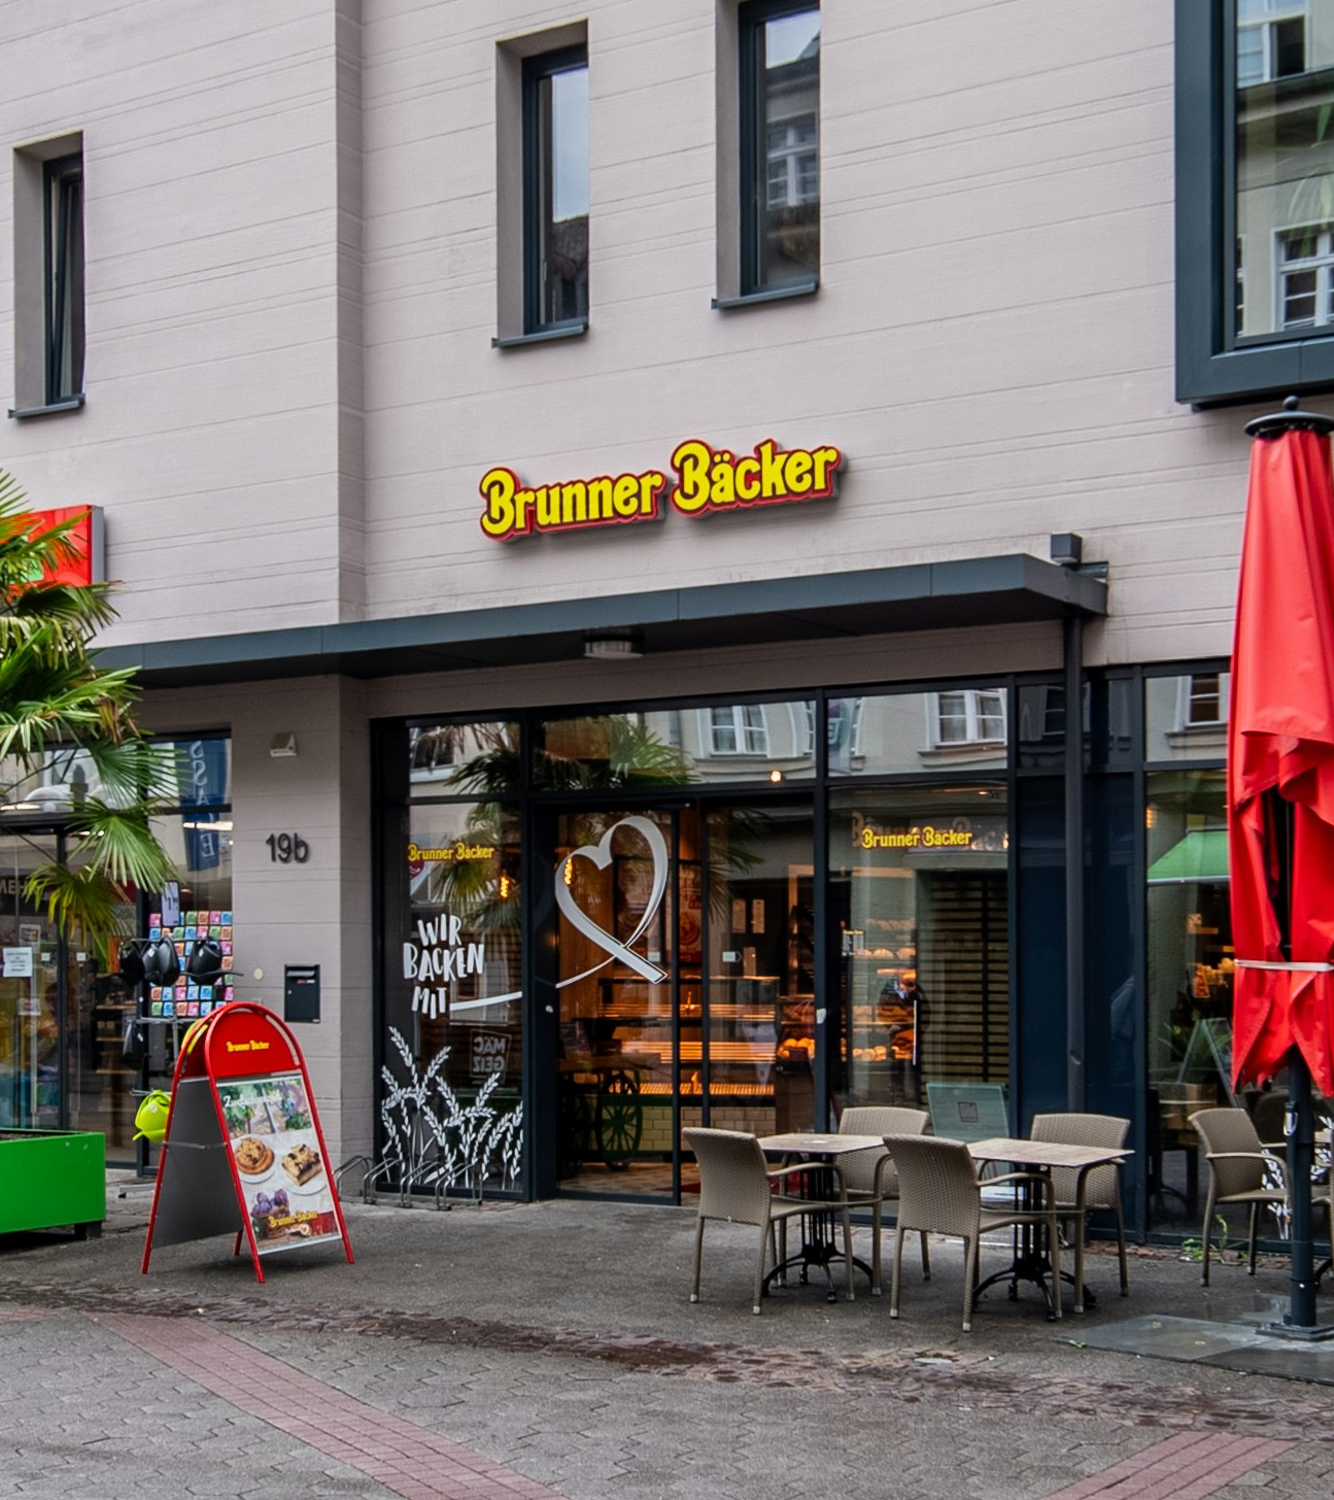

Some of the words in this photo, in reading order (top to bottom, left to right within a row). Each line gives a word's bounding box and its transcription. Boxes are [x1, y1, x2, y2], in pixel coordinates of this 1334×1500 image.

[479, 467, 665, 538] Brunner
[671, 439, 839, 515] Bäcker
[266, 833, 310, 863] 19b
[408, 844, 454, 862] Brunner
[455, 842, 495, 860] Bäcker
[862, 828, 920, 849] Brunner
[922, 826, 973, 847] Bäcker
[417, 913, 462, 947] WIR
[403, 942, 485, 982] BACKEN
[411, 986, 447, 1020] MIT
